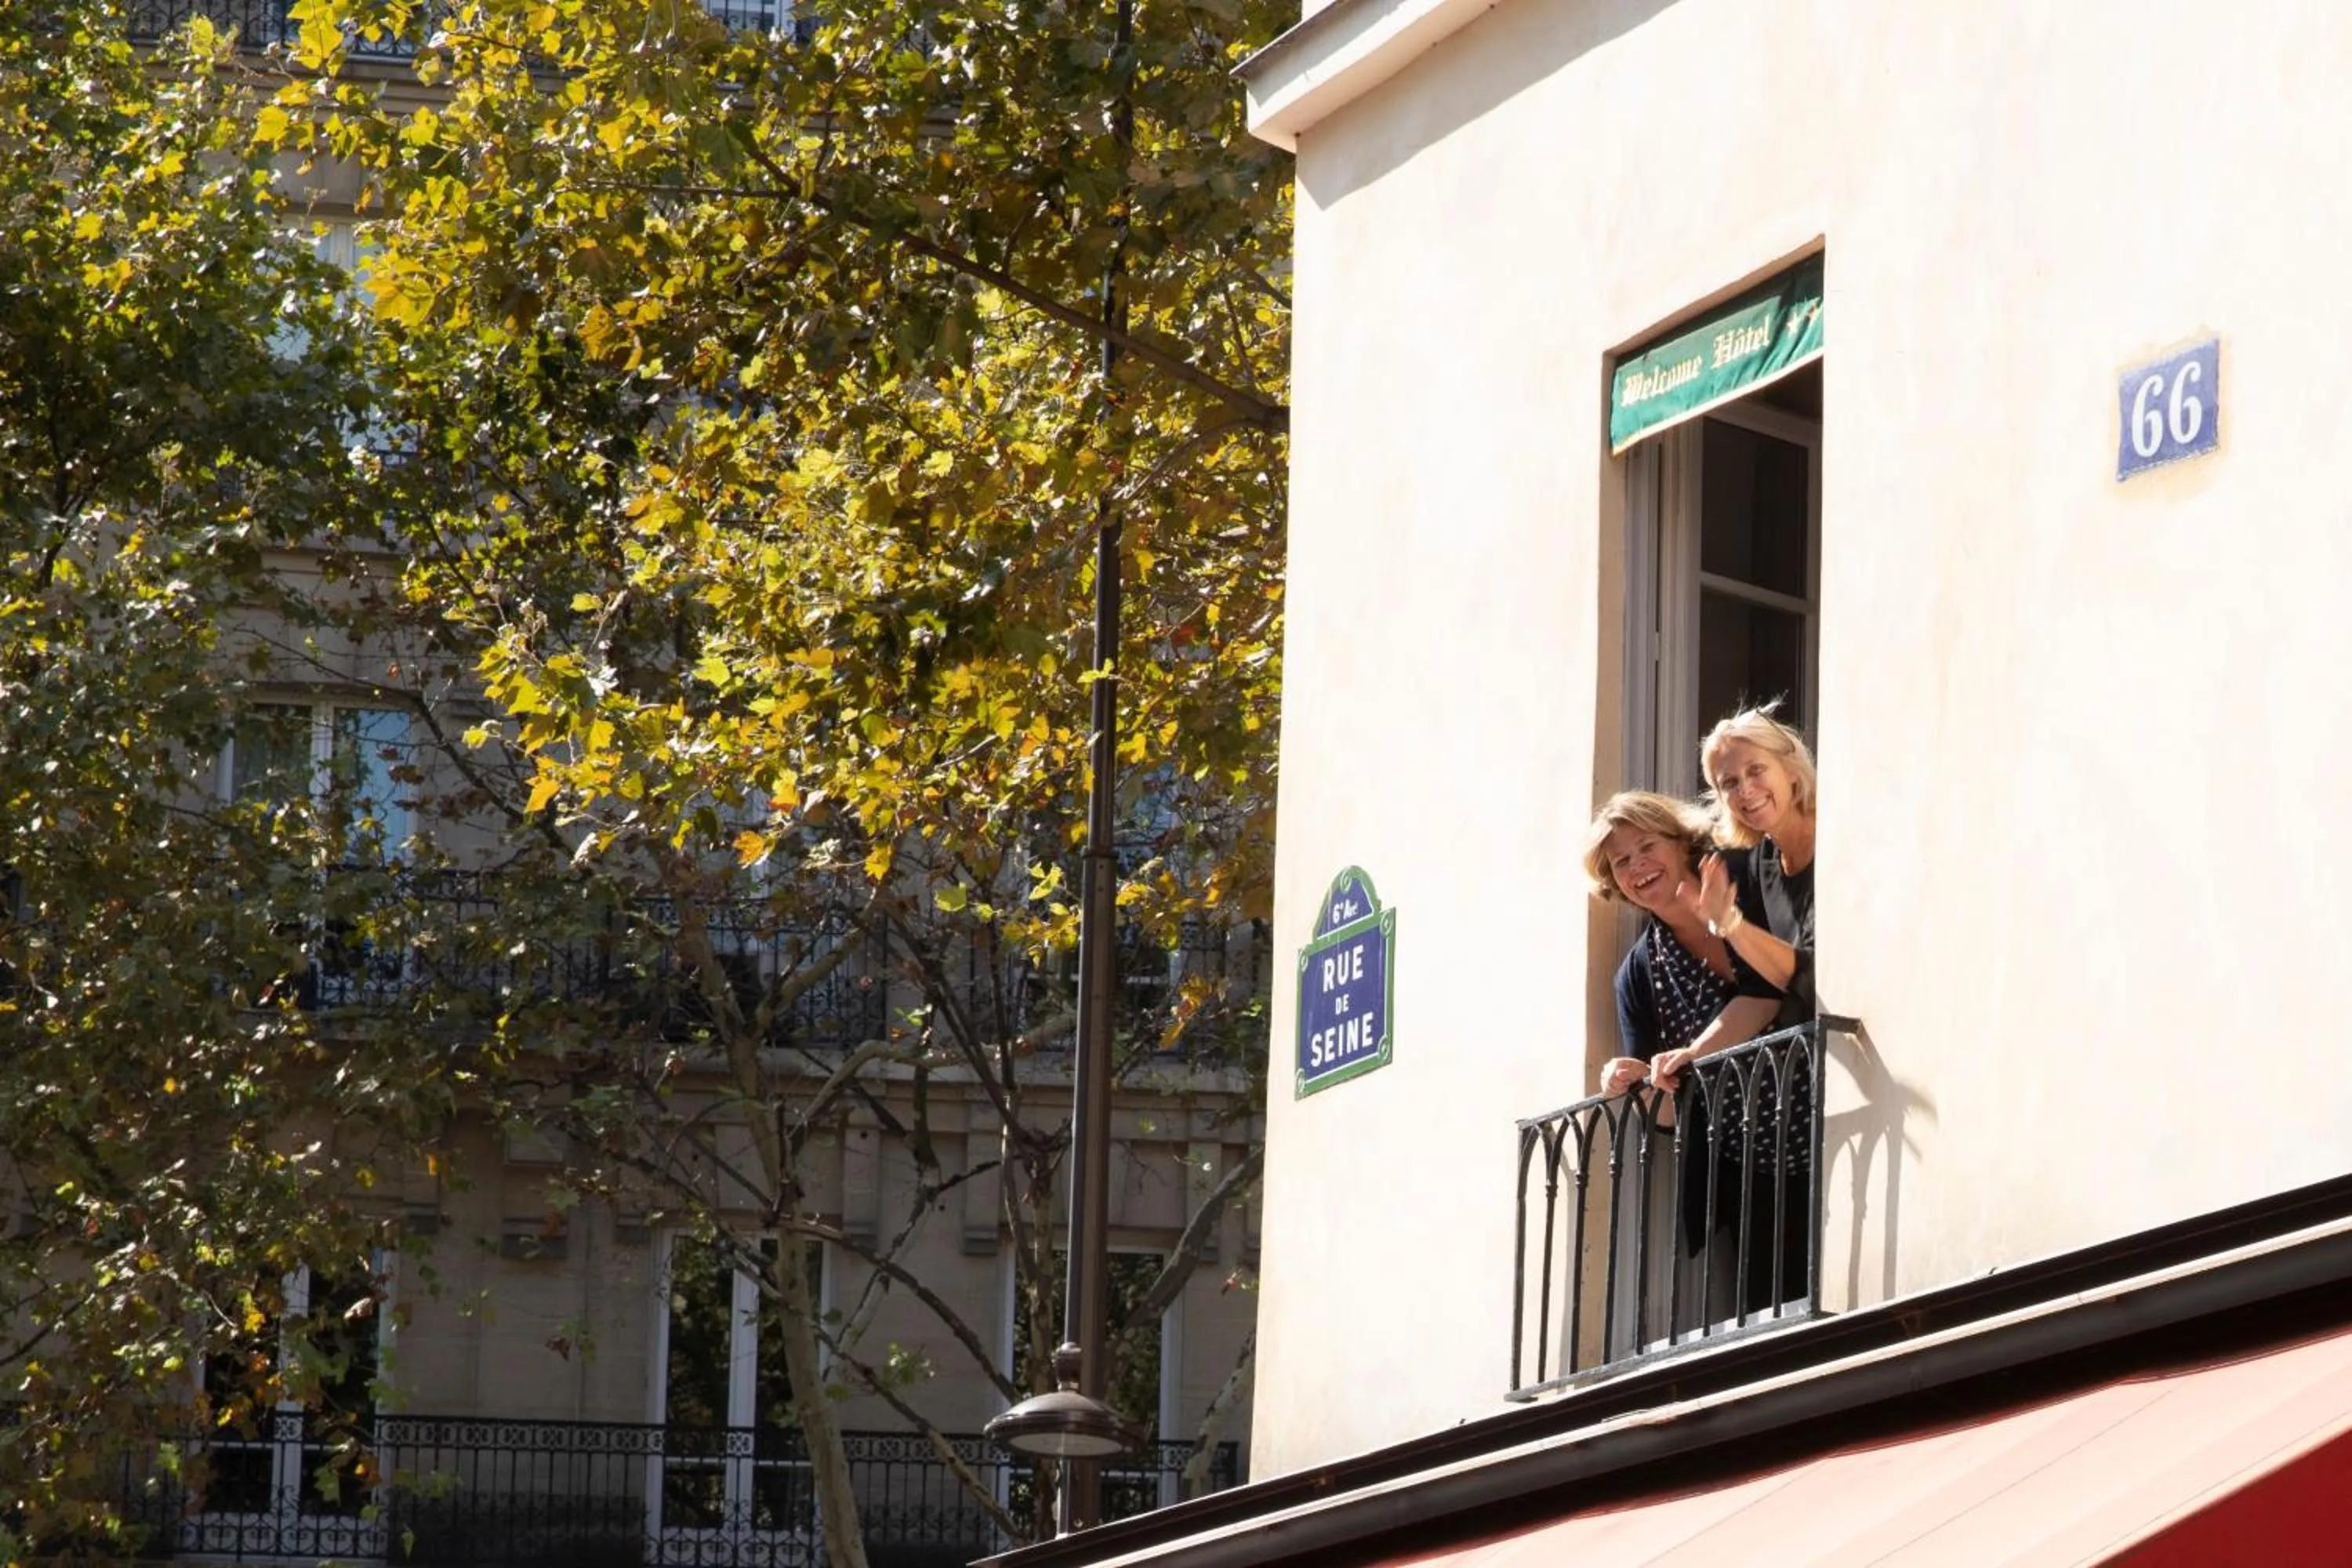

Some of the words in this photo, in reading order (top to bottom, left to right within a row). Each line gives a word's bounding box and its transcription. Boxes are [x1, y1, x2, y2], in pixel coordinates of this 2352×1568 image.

[1621, 355, 1703, 407] Welcome
[2132, 361, 2202, 458] 66
[1323, 945, 1364, 993] RUE
[1335, 994, 1349, 1014] DE
[1311, 1012, 1374, 1067] SEINE
